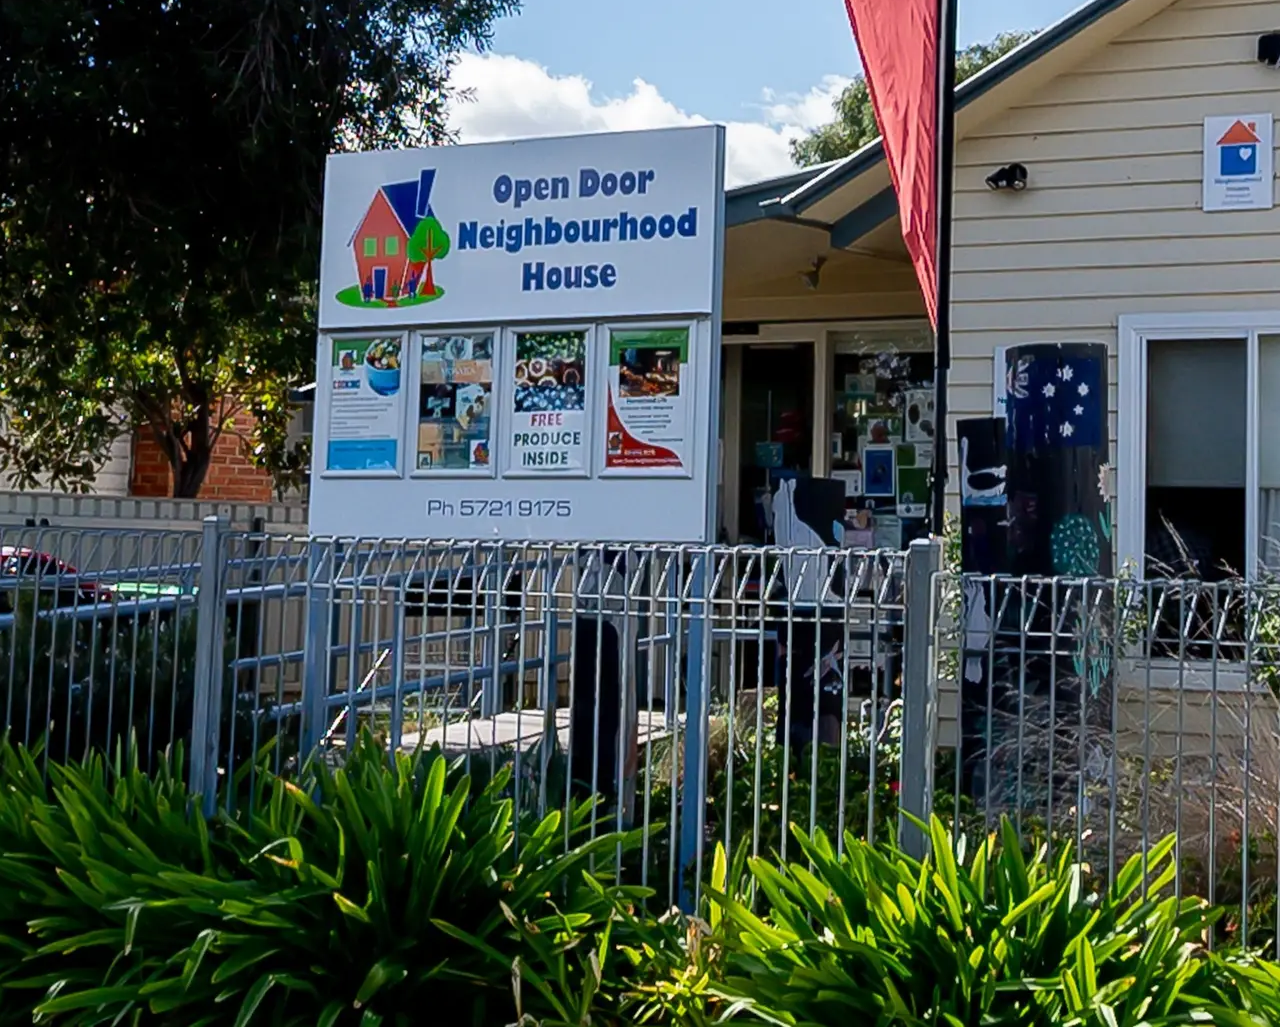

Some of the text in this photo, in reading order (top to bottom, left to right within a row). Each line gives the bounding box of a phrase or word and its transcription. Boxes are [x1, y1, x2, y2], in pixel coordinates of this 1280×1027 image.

[493, 168, 655, 208] Open Door
[457, 207, 698, 253] Neighbourhood
[522, 261, 617, 291] House
[530, 413, 563, 427] FREE
[513, 431, 581, 447] PRODUCE
[522, 450, 569, 466] INSIDE
[427, 499, 571, 517] Ph 5721 9175
